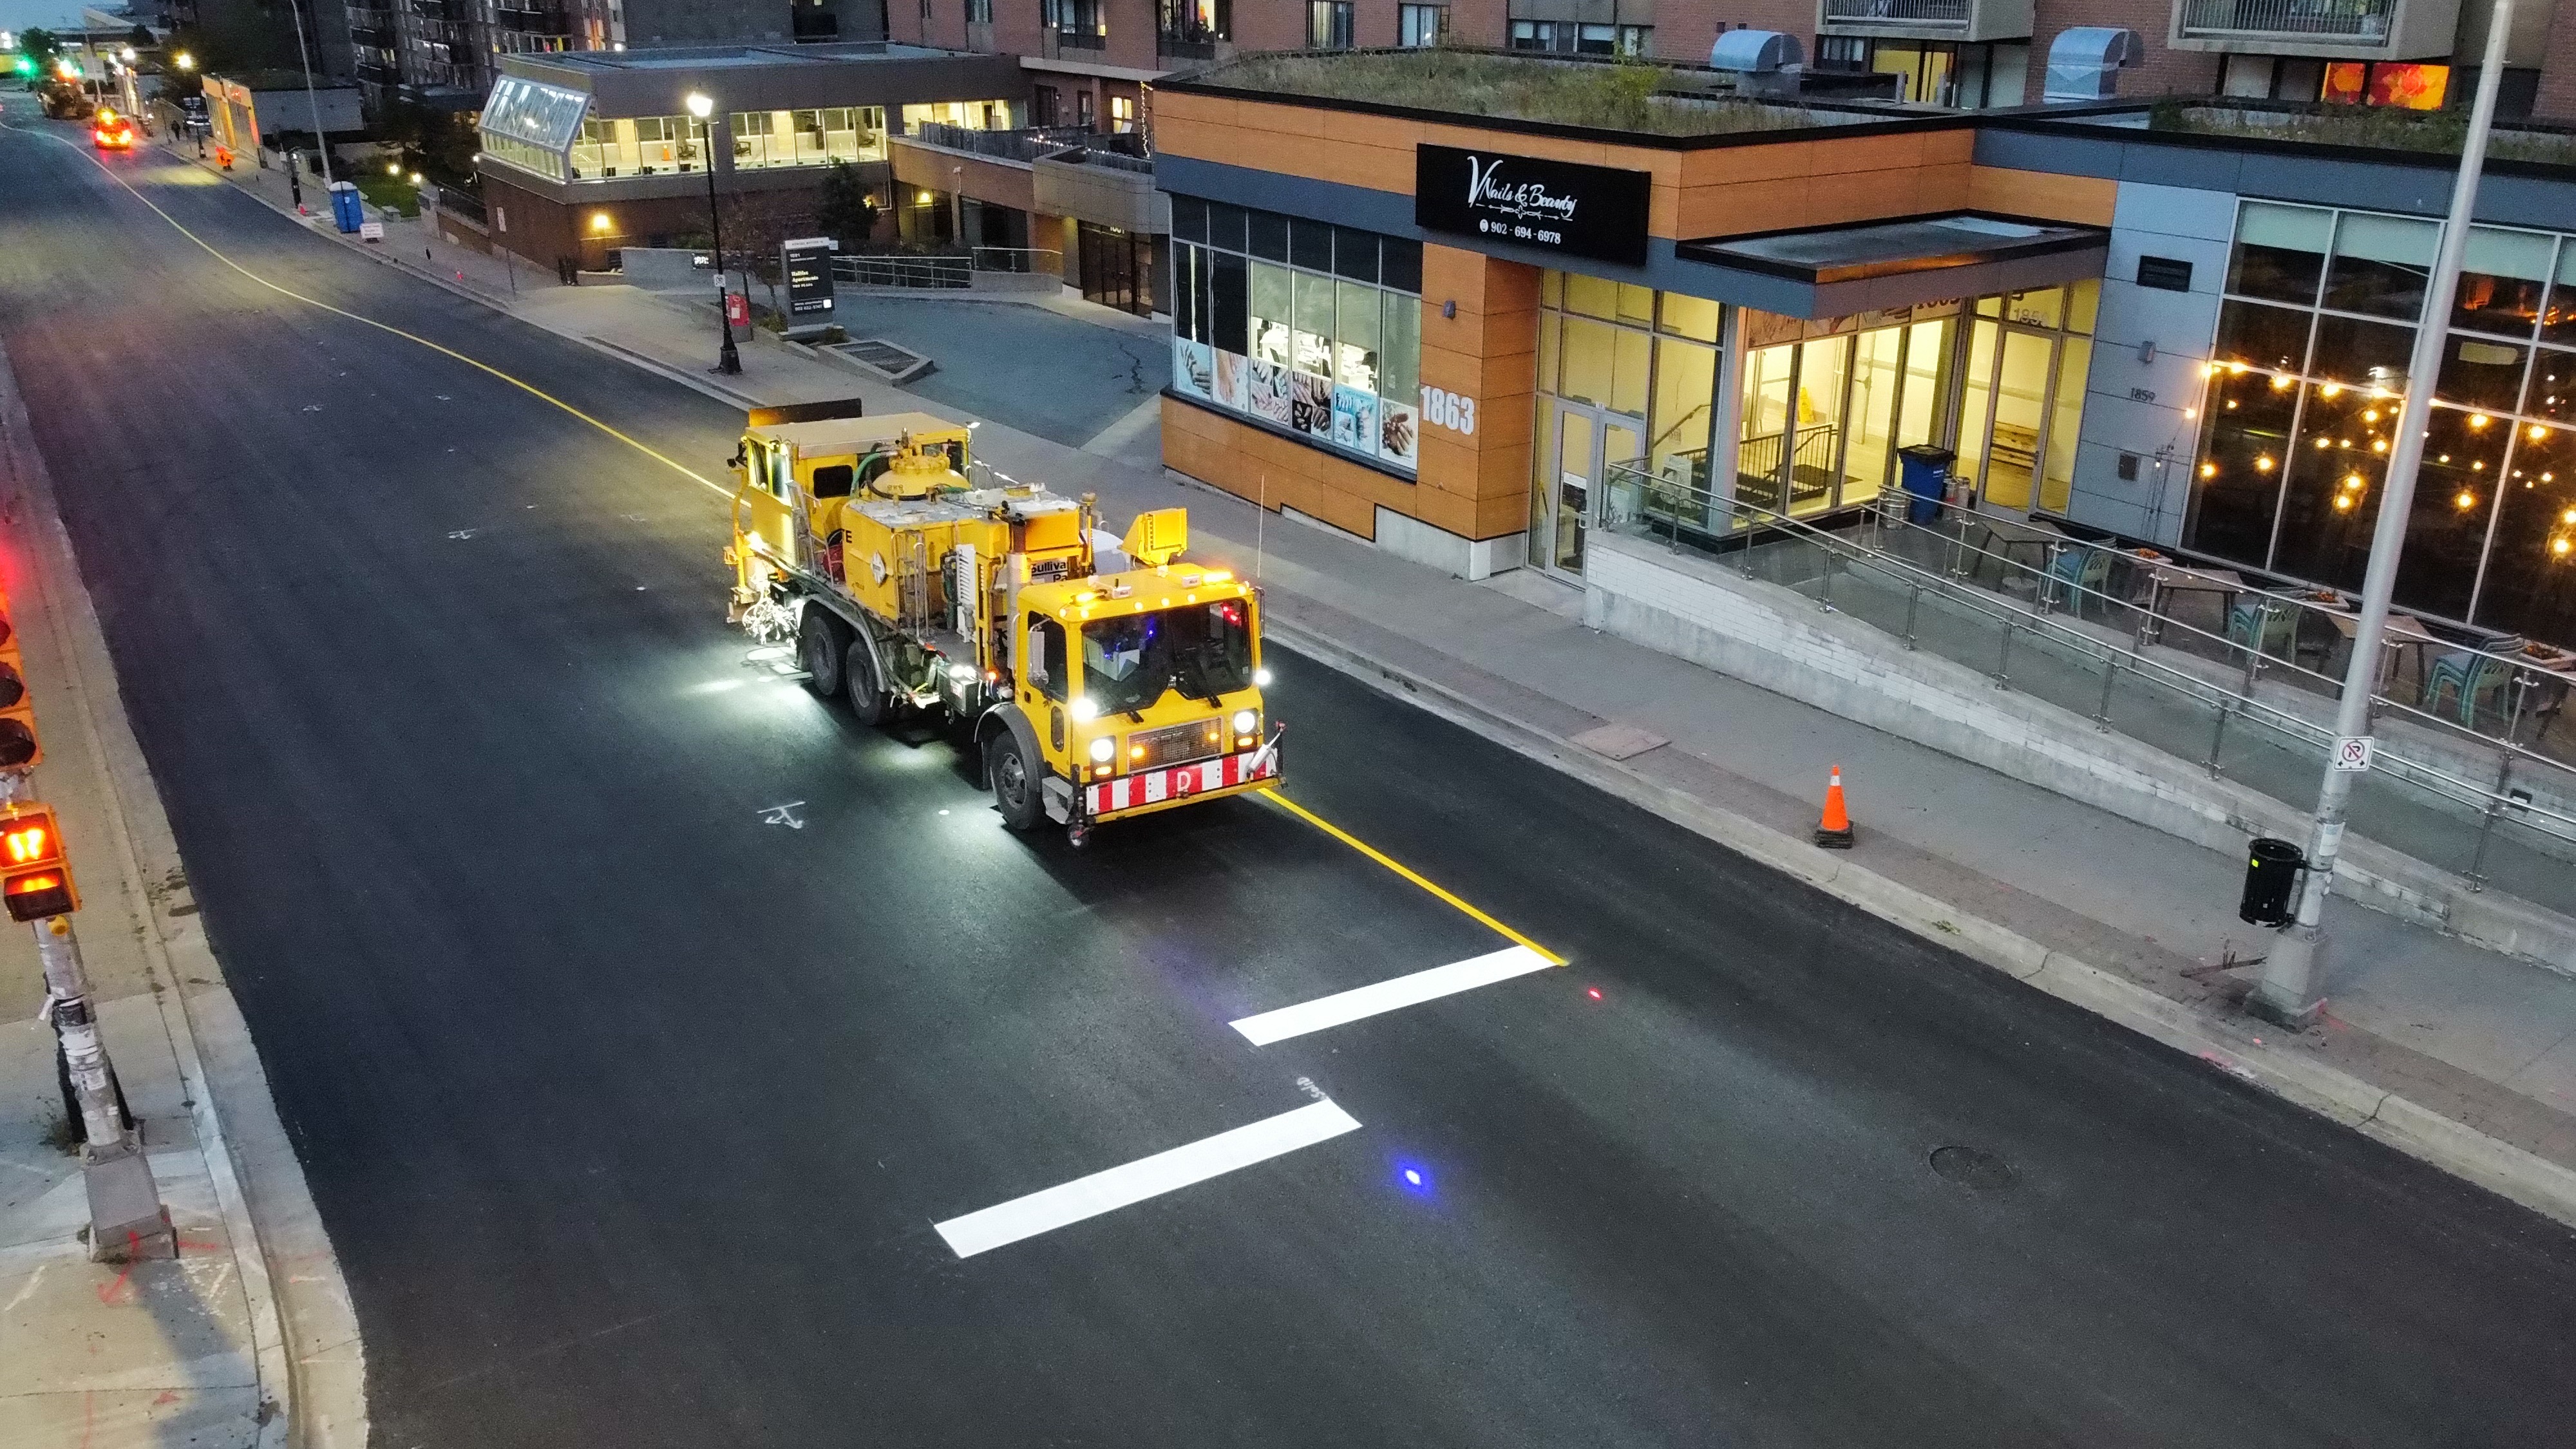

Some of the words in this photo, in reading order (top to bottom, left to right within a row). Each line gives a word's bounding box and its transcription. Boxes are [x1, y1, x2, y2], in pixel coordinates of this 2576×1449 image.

[1479, 177, 1513, 201] Nails
[1515, 184, 1528, 207] &
[1530, 184, 1577, 218] Beauty
[2131, 387, 2155, 402] 1859
[1420, 386, 1475, 435] 1863
[1177, 771, 1191, 791] D
